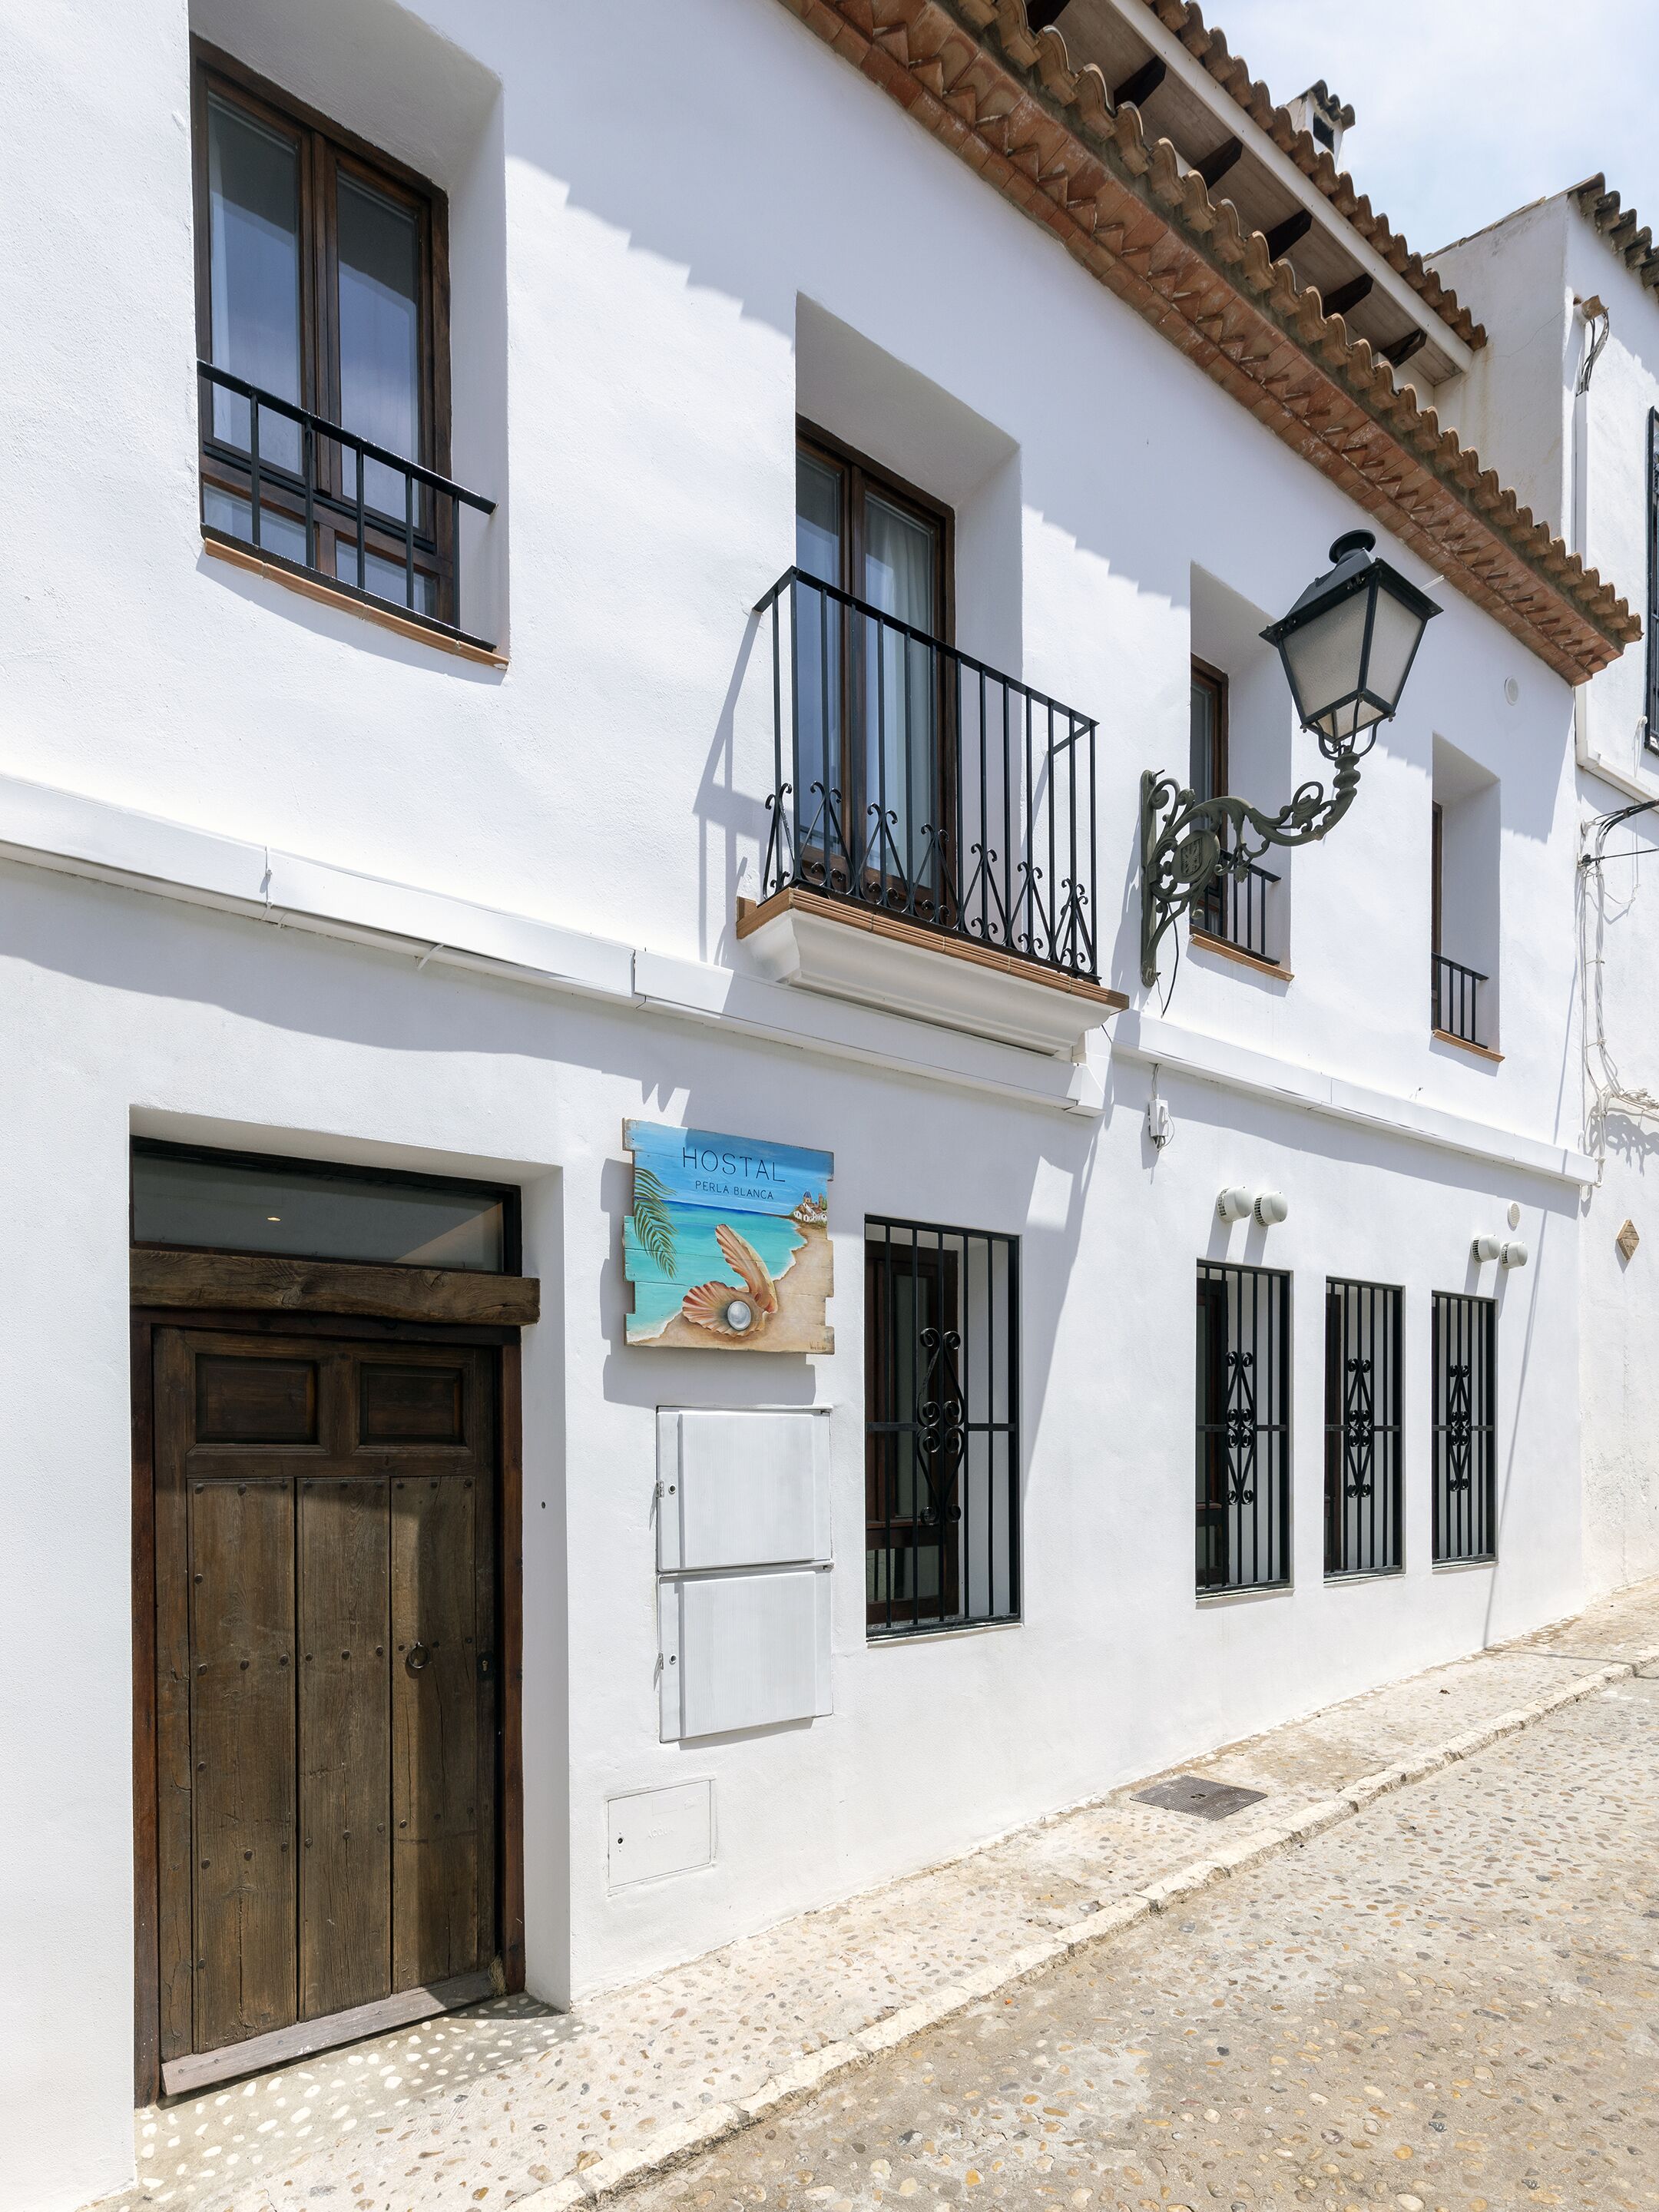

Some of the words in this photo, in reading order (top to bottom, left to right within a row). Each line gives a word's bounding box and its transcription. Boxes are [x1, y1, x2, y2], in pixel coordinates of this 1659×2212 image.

[683, 1147, 785, 1182] HOSTAL
[695, 1180, 730, 1194] PERLA
[733, 1187, 774, 1200] BLANCA
